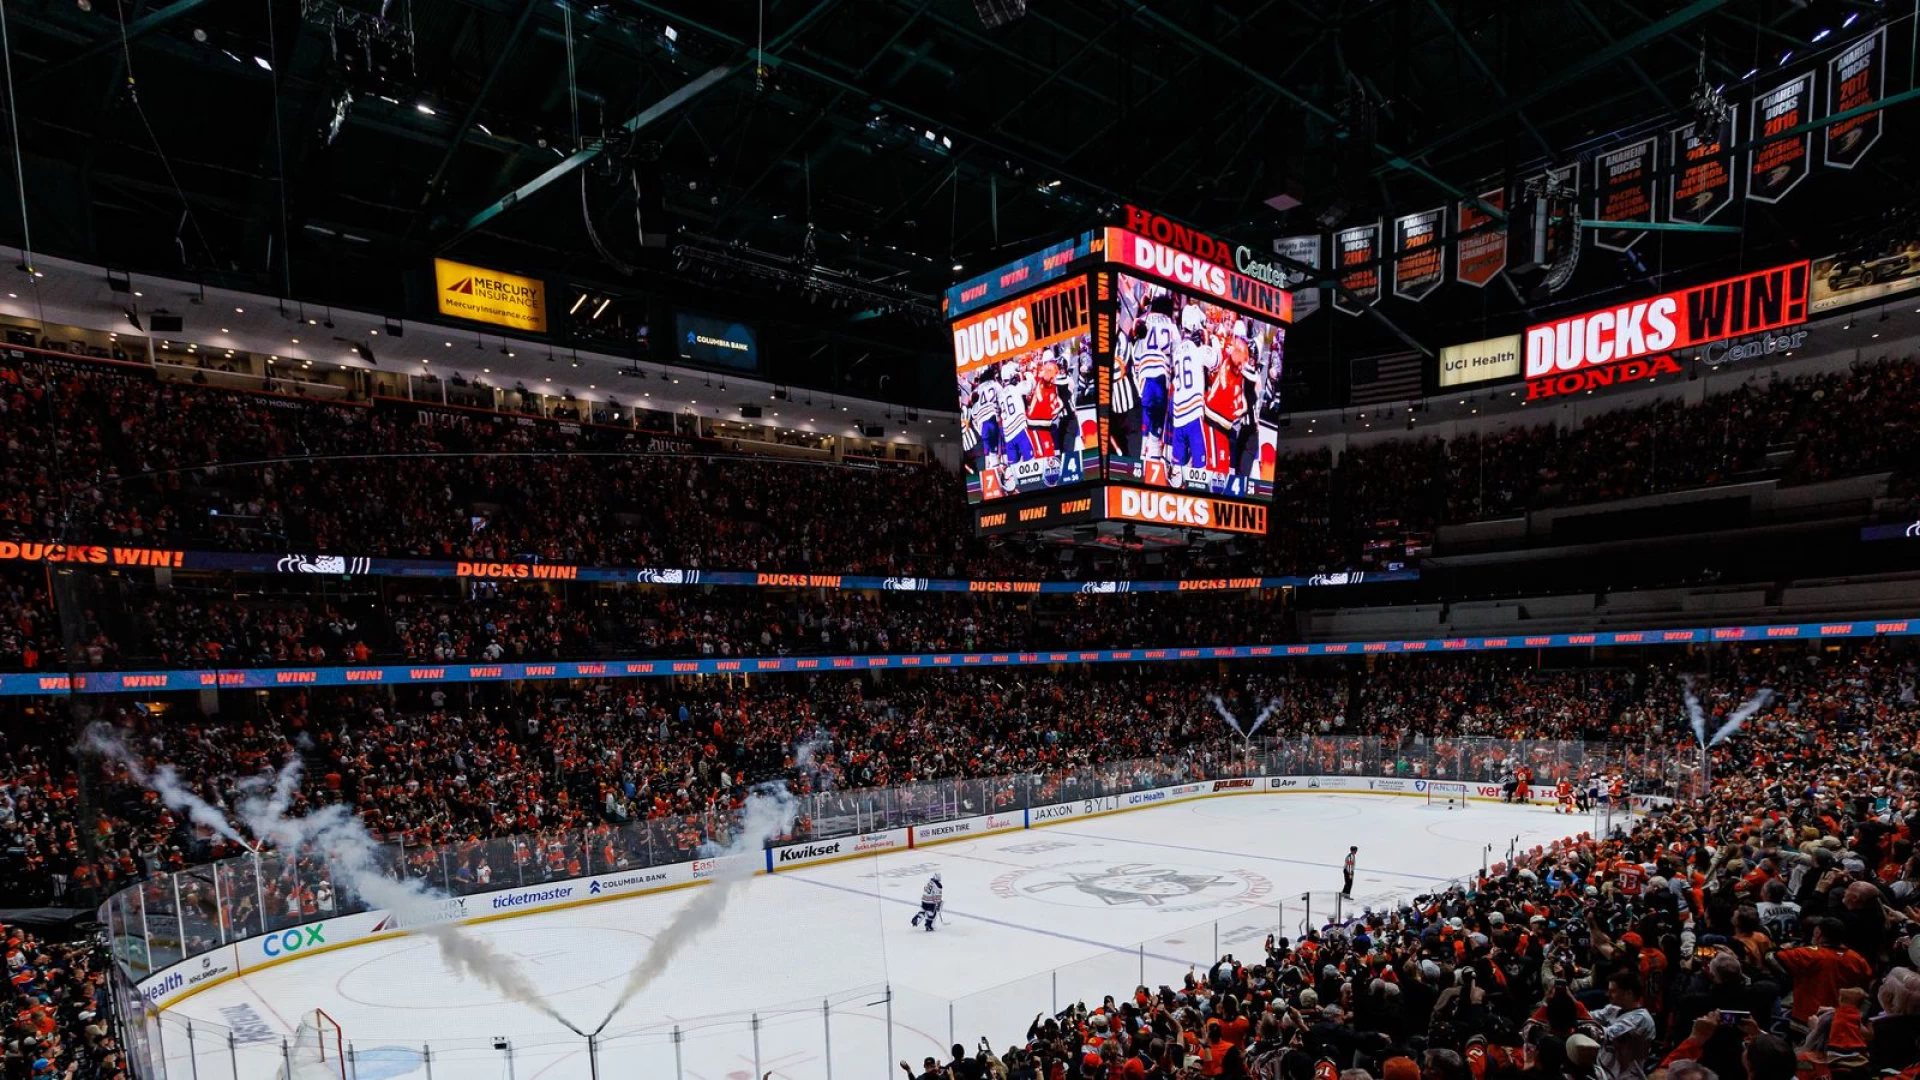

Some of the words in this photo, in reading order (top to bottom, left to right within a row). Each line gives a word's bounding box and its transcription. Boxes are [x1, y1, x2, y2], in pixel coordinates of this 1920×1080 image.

[1837, 37, 1875, 72] ANAHEIM
[1841, 54, 1870, 82] DUCKS
[1762, 80, 1804, 110] ANAHEIM
[1840, 69, 1868, 100] 2017
[1765, 95, 1798, 120] DUCKS
[1764, 109, 1799, 138] 2016
[1606, 144, 1646, 167] ANAHEIM
[1610, 158, 1641, 177] DUCKS
[1124, 204, 1235, 268] HONDA
[1236, 246, 1287, 288] Center
[961, 283, 987, 302] WIN!
[1000, 267, 1029, 288] WIN!
[1043, 249, 1074, 271] WIN!
[1135, 237, 1226, 295] DUCKS
[1230, 274, 1280, 315] WIN!
[474, 277, 537, 298] MERCURY
[474, 288, 539, 308] INSURANCE
[446, 298, 540, 323] MercuryInsurance.com
[1527, 297, 1676, 377] DUCKS
[1687, 263, 1806, 343] WIN!
[954, 306, 1028, 366] DUCKS
[1032, 283, 1088, 341] WIN!
[697, 335, 729, 349] COLUMBIA
[730, 341, 748, 351] BANK
[1445, 360, 1467, 372] UCI
[1472, 350, 1515, 367] Health
[1527, 355, 1681, 399] HONDA
[1704, 330, 1807, 366] Center
[1019, 462, 1039, 475] 00.0
[1067, 458, 1077, 472] 4
[1151, 464, 1161, 483] 7
[1189, 469, 1206, 481] 00.0
[986, 474, 994, 489] 7
[1231, 477, 1240, 495] 4
[980, 513, 1007, 527] WIN!
[1019, 506, 1047, 521] WIN!
[1061, 498, 1091, 514] WIN!
[1121, 490, 1209, 525] DUCKS
[1213, 503, 1264, 530] WIN!
[0, 541, 108, 563] DUCKS
[113, 549, 184, 567] WIN!
[456, 562, 528, 578] DUCKS
[532, 565, 577, 579] WIN!
[757, 573, 807, 587] DUCKS
[809, 575, 841, 587] WIN!
[969, 581, 1011, 592] DUCKS
[1013, 582, 1041, 592] WIN!
[1179, 579, 1227, 590] DUCKS
[1229, 578, 1262, 588] WIN!
[123, 675, 168, 687] WIN!
[276, 671, 317, 683] WIN!
[346, 670, 383, 681] WIN!
[410, 668, 444, 679] WIN!
[470, 667, 502, 678] WIN!
[526, 665, 556, 676] WIN!
[578, 665, 606, 674] WIN!
[627, 663, 654, 673] WIN!
[673, 662, 698, 672] WIN!
[717, 661, 741, 670] WIN!
[758, 660, 780, 669] WIN!
[1363, 643, 1386, 652] WIN!
[1403, 642, 1426, 650] WIN!
[1443, 640, 1467, 649] WIN!
[1484, 638, 1508, 648] WIN!
[1525, 637, 1550, 646] WIN!
[1568, 635, 1595, 644] WIN!
[1614, 633, 1642, 642] WIN!
[1664, 631, 1694, 640] WIN!
[1715, 629, 1746, 639] WIN!
[1766, 626, 1798, 637] WIN!
[1820, 624, 1852, 635] WIN!
[1876, 622, 1908, 633] WIN!
[1129, 795, 1141, 804] UCI
[1143, 791, 1165, 801] Health
[1477, 785, 1534, 799] vern
[1084, 795, 1120, 814] BYLT
[931, 826, 954, 835] NEXEN
[955, 823, 970, 832] TIRE
[780, 841, 841, 862] Kwikset
[603, 876, 644, 889] COLUMBIA
[646, 873, 667, 884] BANK
[493, 885, 573, 908] ticketmaster
[263, 923, 325, 956] COX
[142, 972, 183, 1000] Health
